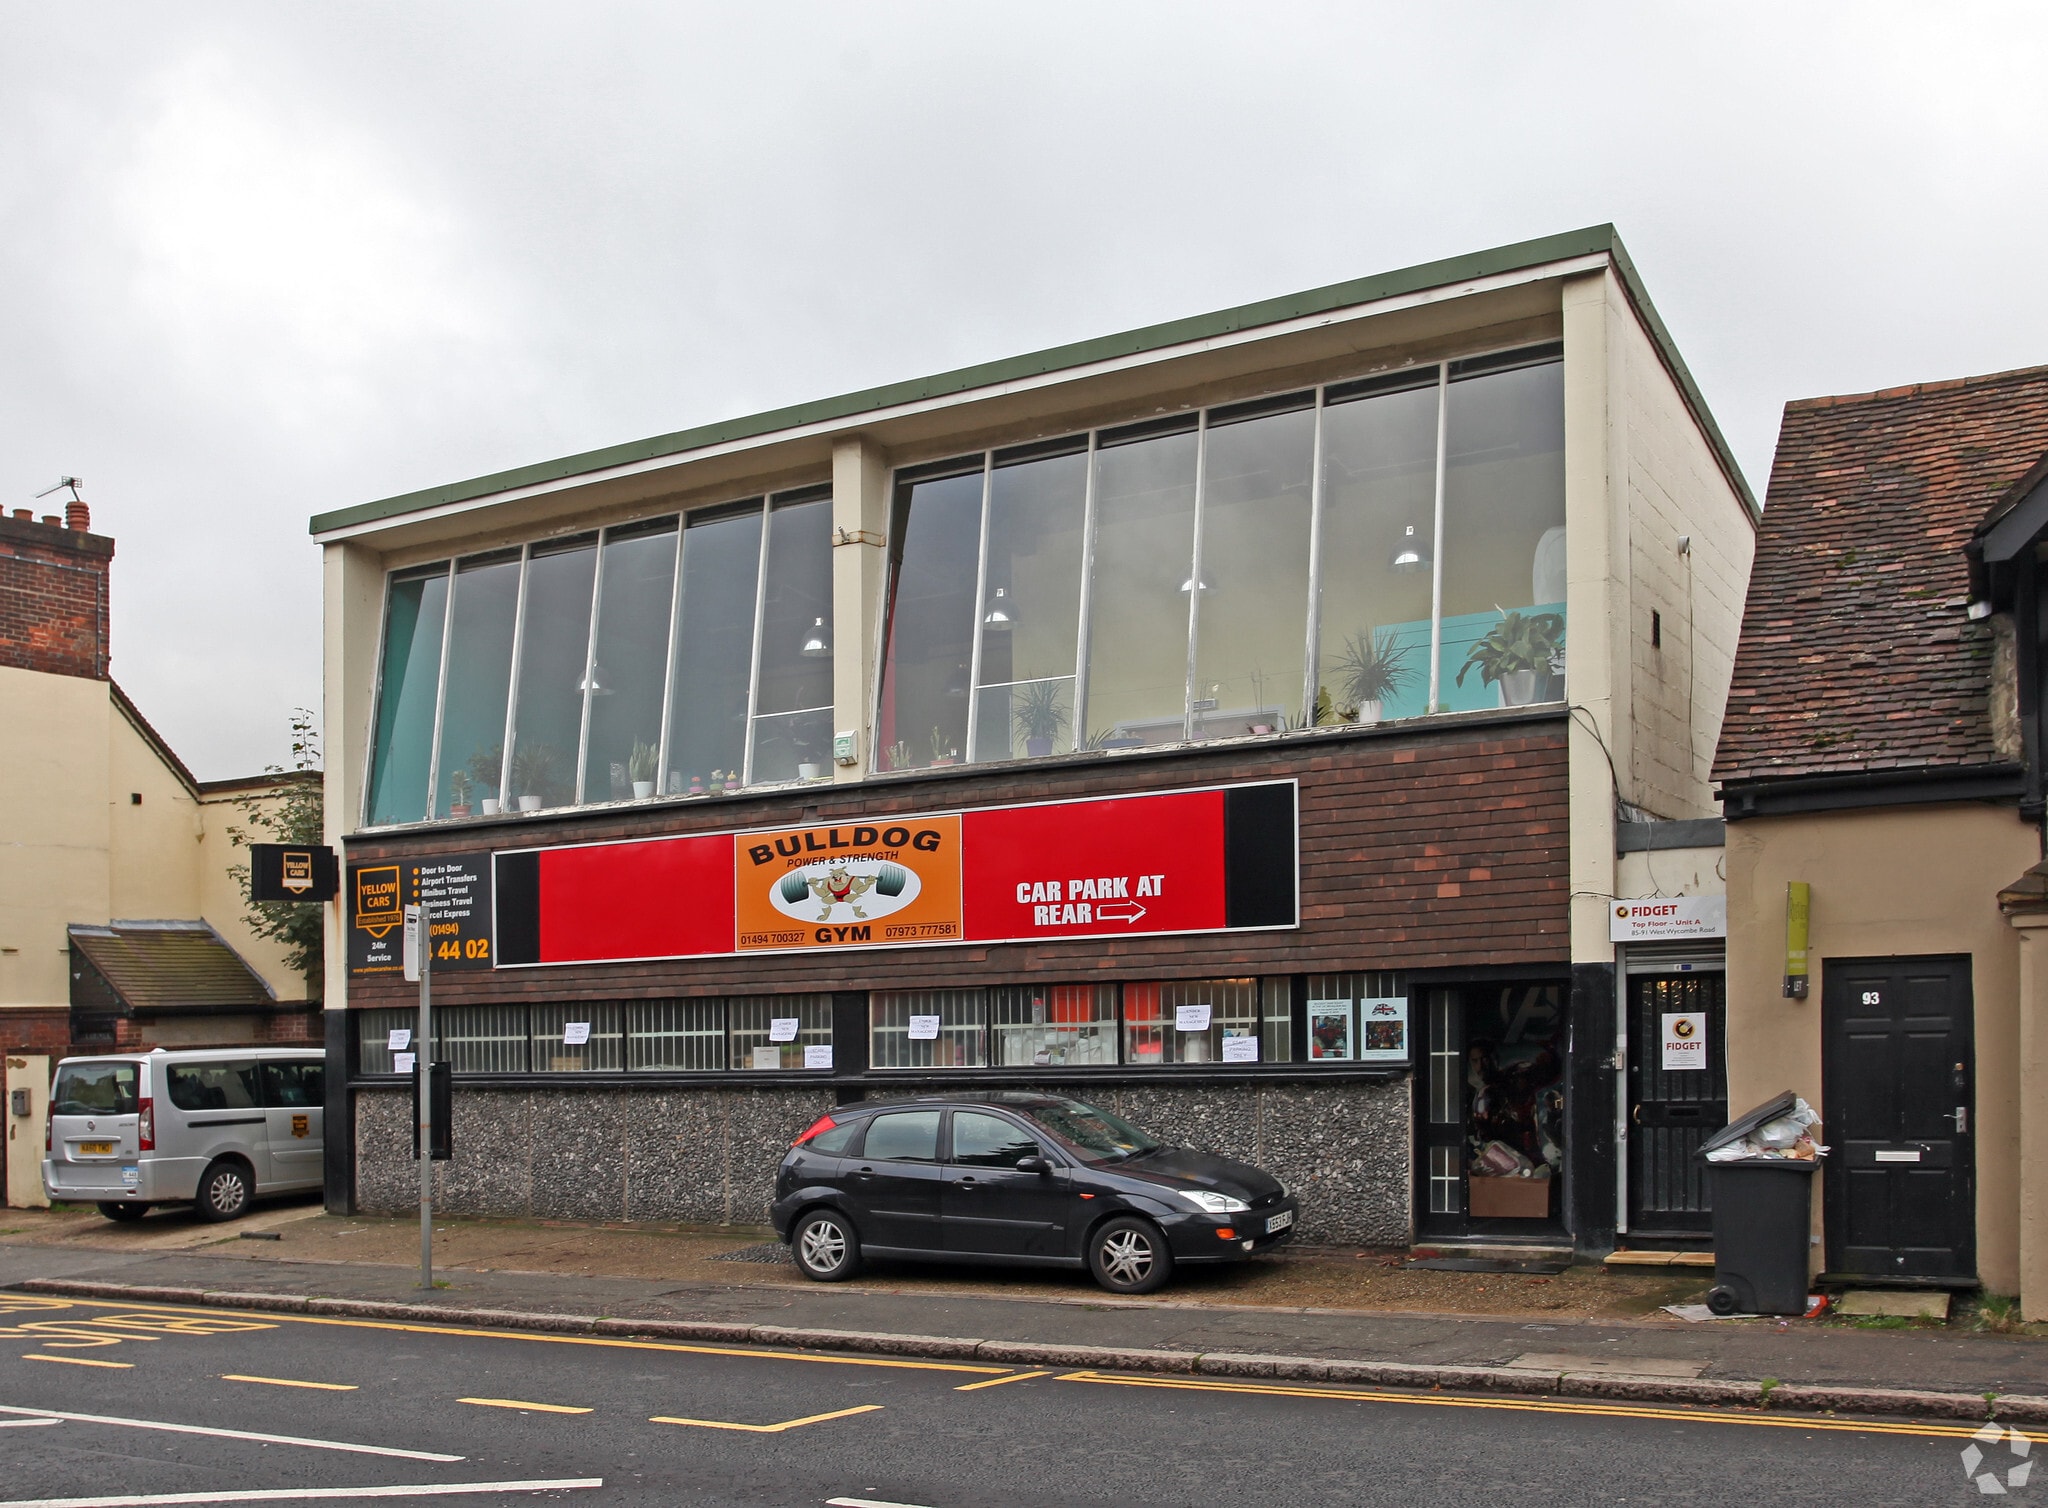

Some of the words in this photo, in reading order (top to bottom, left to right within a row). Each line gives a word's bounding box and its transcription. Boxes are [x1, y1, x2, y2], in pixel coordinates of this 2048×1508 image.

[748, 826, 942, 866] BULLDOG
[286, 861, 309, 869] YELLOW
[787, 856, 826, 868] POWER
[829, 856, 836, 865] &
[839, 850, 899, 864] STRENGTH
[421, 866, 436, 875] Door
[447, 864, 462, 873] Door
[421, 876, 445, 887] Airport
[446, 873, 478, 883] Transfers
[361, 882, 396, 896] YELLOW
[421, 889, 447, 897] Minibus
[448, 886, 469, 895] Travel
[1016, 880, 1062, 904] CAR
[1068, 876, 1129, 900] PARK
[1136, 874, 1165, 897] AT
[367, 896, 391, 908] CARS
[421, 899, 451, 908] Business
[452, 897, 473, 906] Travel
[429, 909, 442, 918] rcel
[444, 909, 471, 919] Express
[1034, 902, 1093, 926] REAR
[1631, 904, 1678, 917] FIDGET
[358, 914, 387, 926] Established
[1632, 921, 1646, 929] Top
[429, 922, 459, 937] (01494)
[815, 925, 871, 944] GYM
[886, 926, 917, 937] 07973
[920, 924, 957, 936] 777581
[1666, 927, 1697, 936] Wycombe
[740, 934, 769, 945] 01494
[771, 932, 805, 943] 700327
[371, 941, 387, 950] 24hr
[438, 941, 461, 960] 44
[465, 938, 489, 960] 02
[367, 954, 392, 962] Service
[1862, 991, 1880, 1005] 93
[1666, 1041, 1702, 1051] FIDGET
